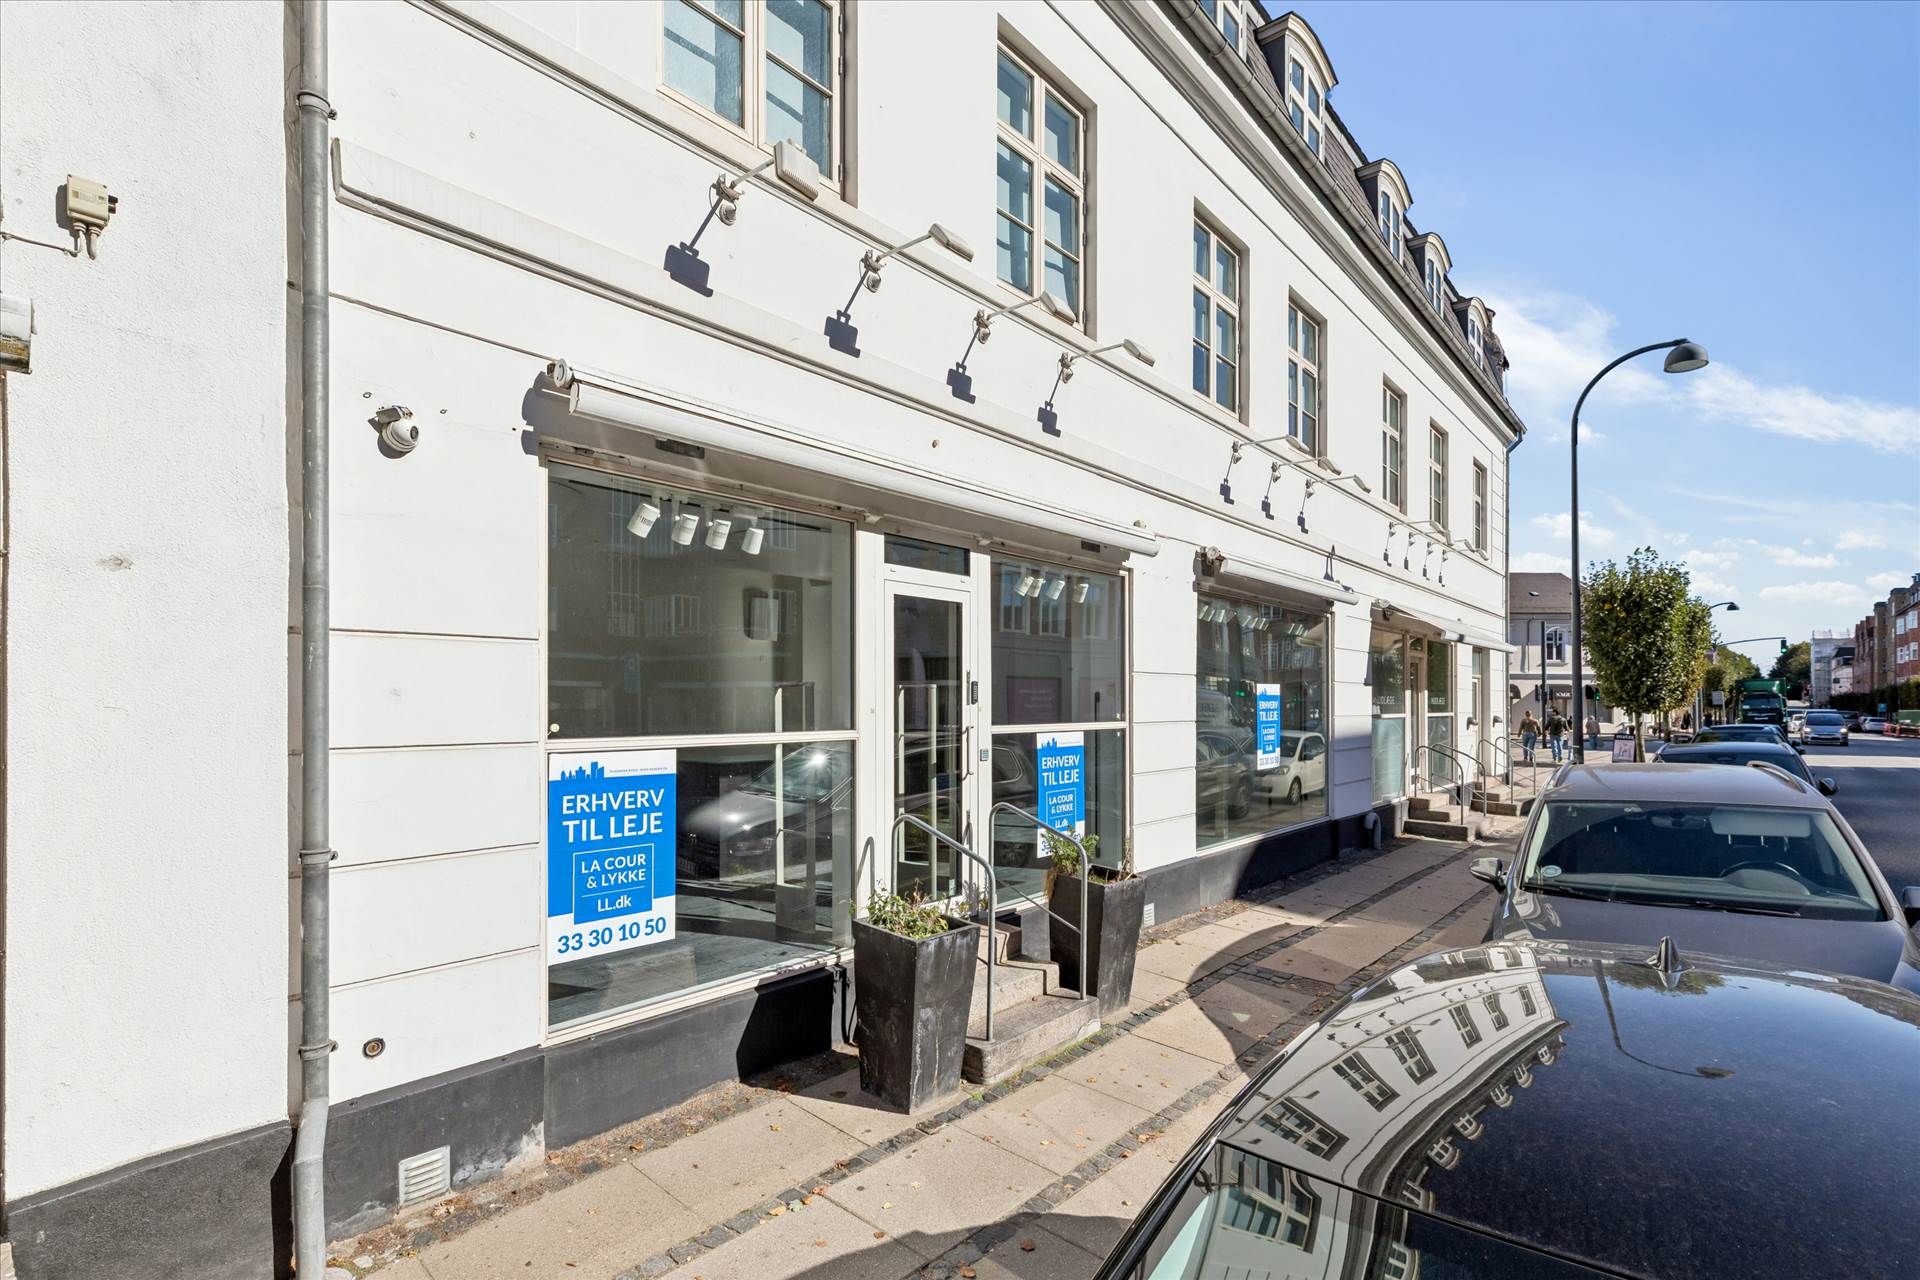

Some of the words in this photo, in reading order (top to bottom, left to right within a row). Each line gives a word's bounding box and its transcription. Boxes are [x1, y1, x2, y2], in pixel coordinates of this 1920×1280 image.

[1041, 754, 1080, 769] ERHVERV
[1042, 771, 1057, 786] TIL
[1059, 769, 1080, 785] LEJE
[562, 788, 665, 815] ERHVERV
[1049, 796, 1057, 805] LA
[1057, 793, 1074, 803] COUR
[562, 818, 604, 843] TIL
[609, 812, 663, 839] LEJE
[581, 859, 601, 874] LA
[604, 853, 647, 870] COUR
[586, 876, 597, 889] &
[601, 868, 646, 887] LYKKE
[597, 895, 632, 912] LL.dk
[557, 932, 583, 954] 33
[588, 927, 613, 948] 30
[618, 921, 640, 941] 10
[644, 916, 667, 936] 50
